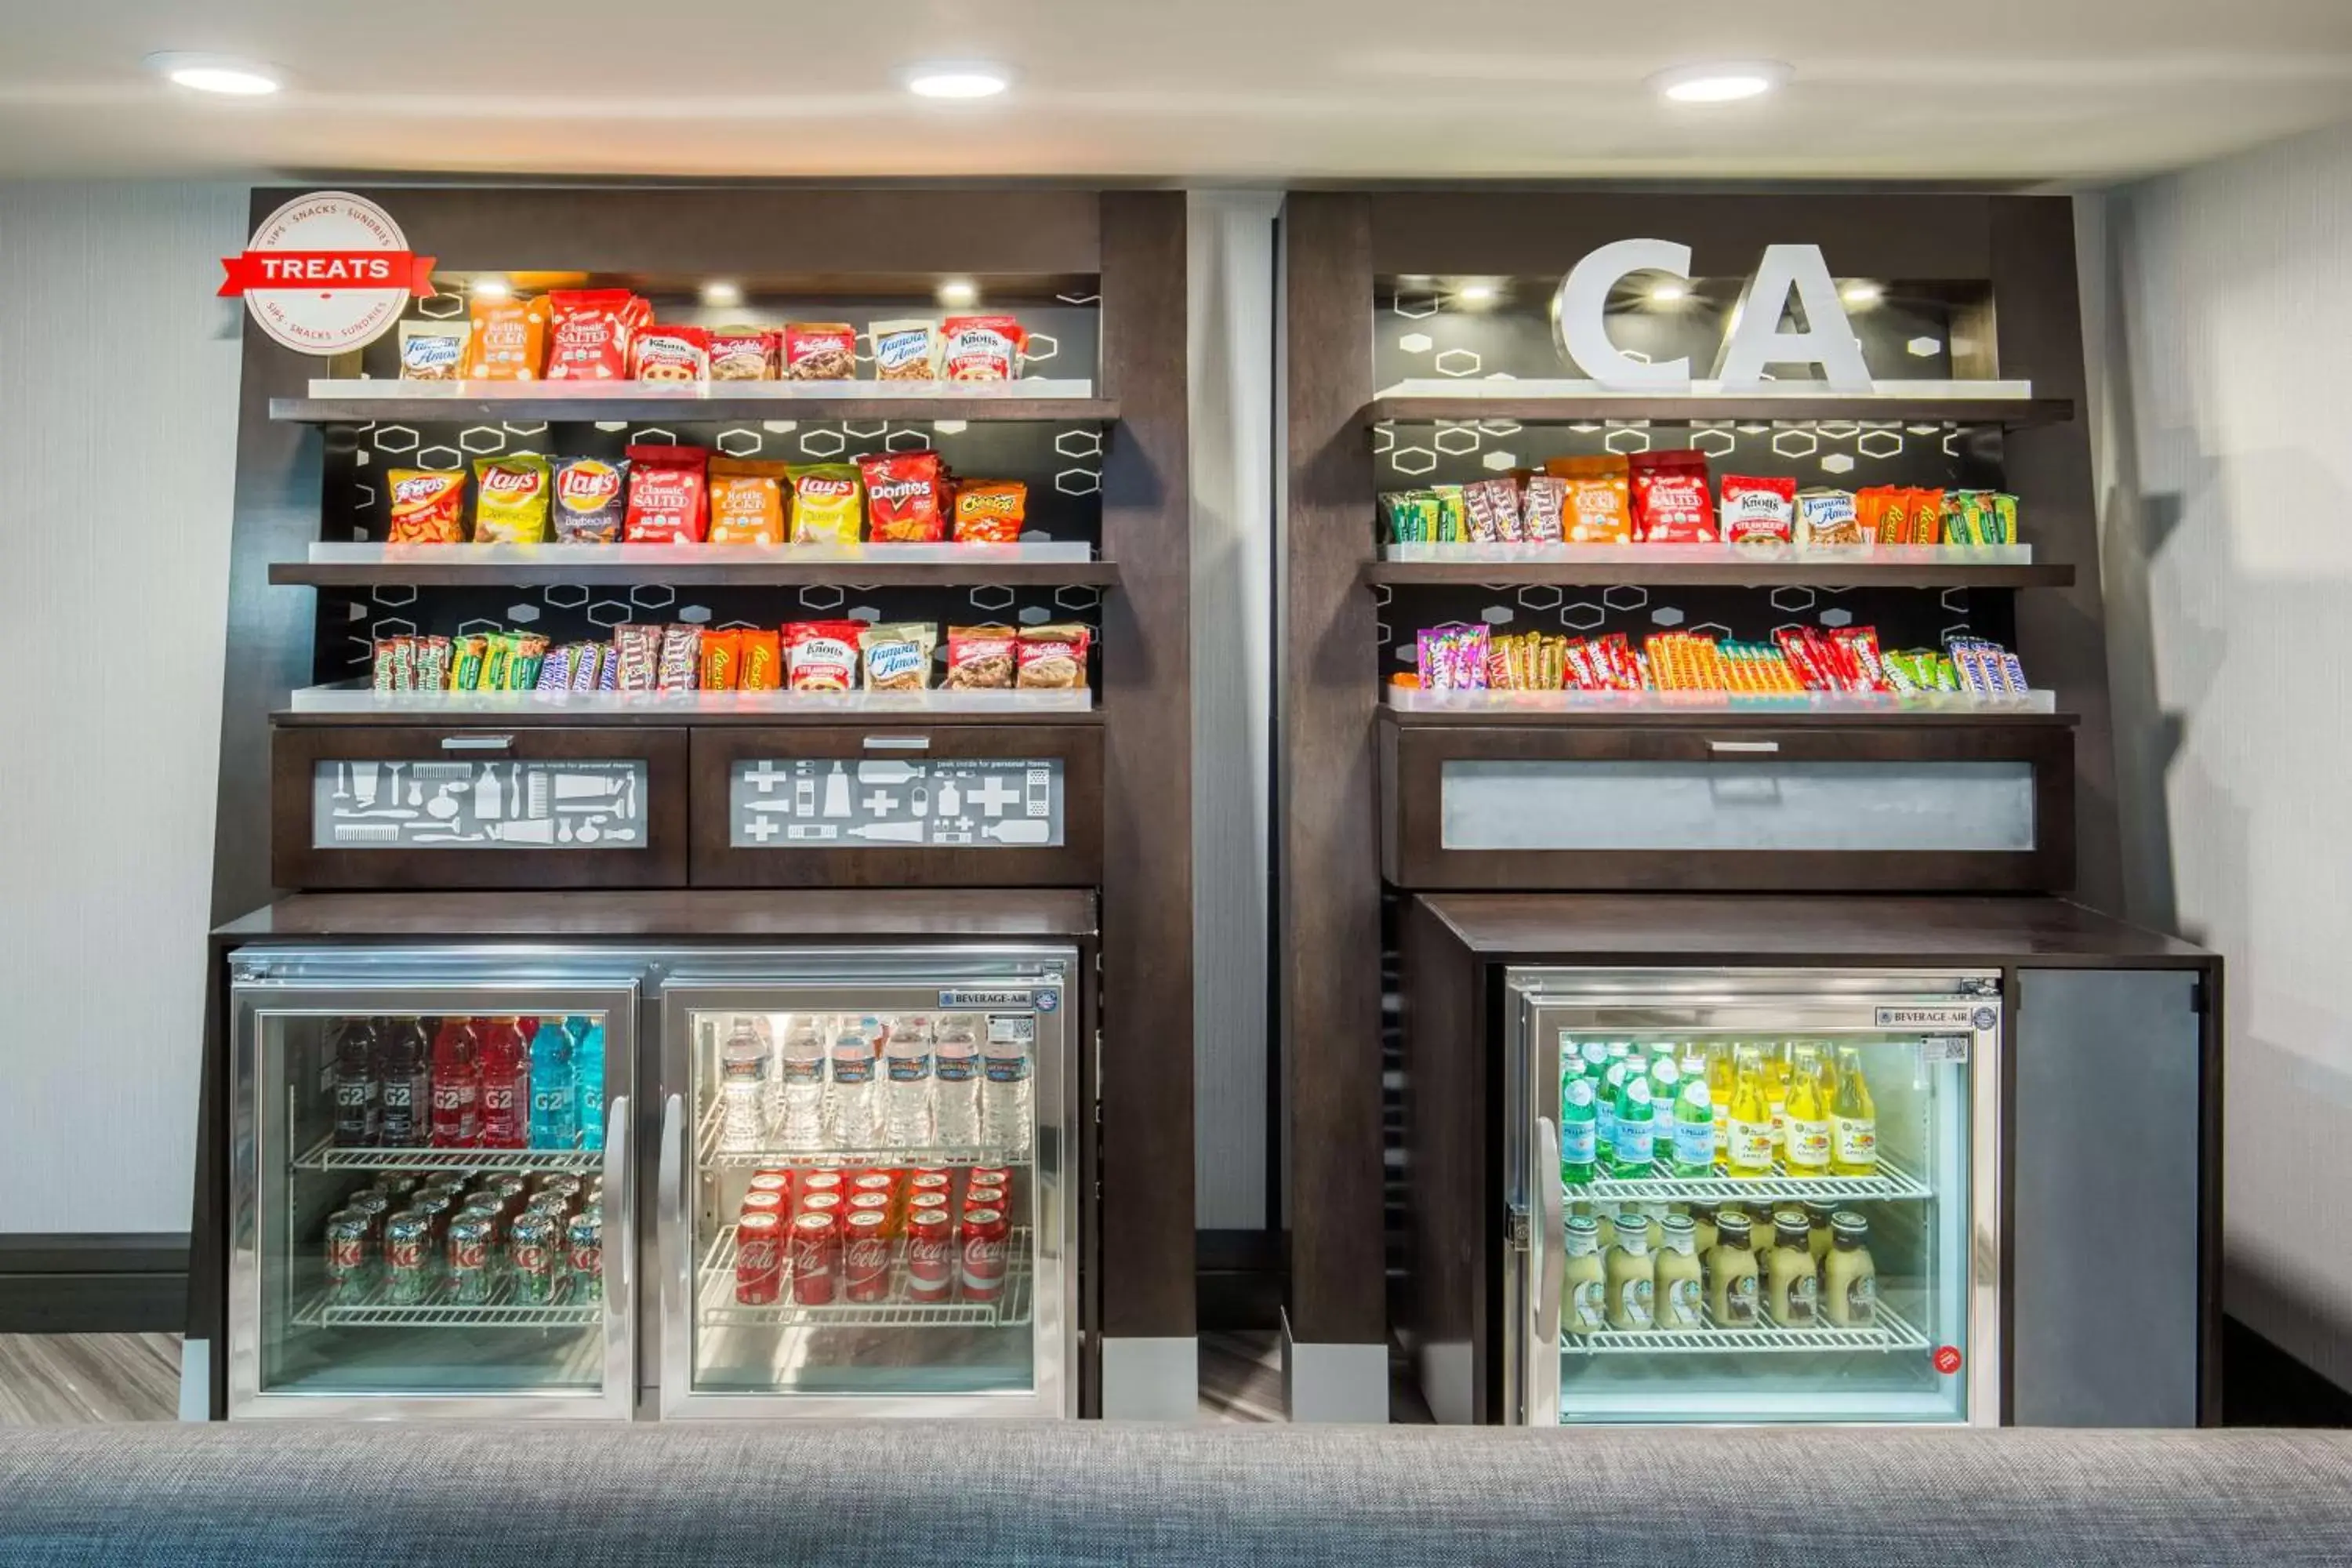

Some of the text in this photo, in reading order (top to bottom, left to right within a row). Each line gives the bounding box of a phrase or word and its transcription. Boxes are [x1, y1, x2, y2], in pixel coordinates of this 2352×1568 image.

[267, 204, 390, 246] SIPS SNACKS SUNDRIES
[261, 258, 390, 279] TREATS
[267, 301, 387, 340] SIPS SNACKS SUNDRIES
[563, 470, 615, 497] Lay's
[869, 480, 931, 499] Doritos
[633, 495, 689, 507] SALTED
[961, 494, 1015, 514] Cheetos
[1886, 505, 1904, 544] Reese
[1920, 505, 1936, 544] Reese
[714, 647, 730, 690] Reese
[956, 993, 1029, 1003] BEVERAGE-AIR
[1894, 1012, 1968, 1022] BEVERAGE-AIR
[338, 1088, 365, 1106] G2
[384, 1088, 411, 1106] G2
[434, 1091, 459, 1109] G2
[486, 1091, 512, 1109] G2
[535, 1093, 563, 1110] G2
